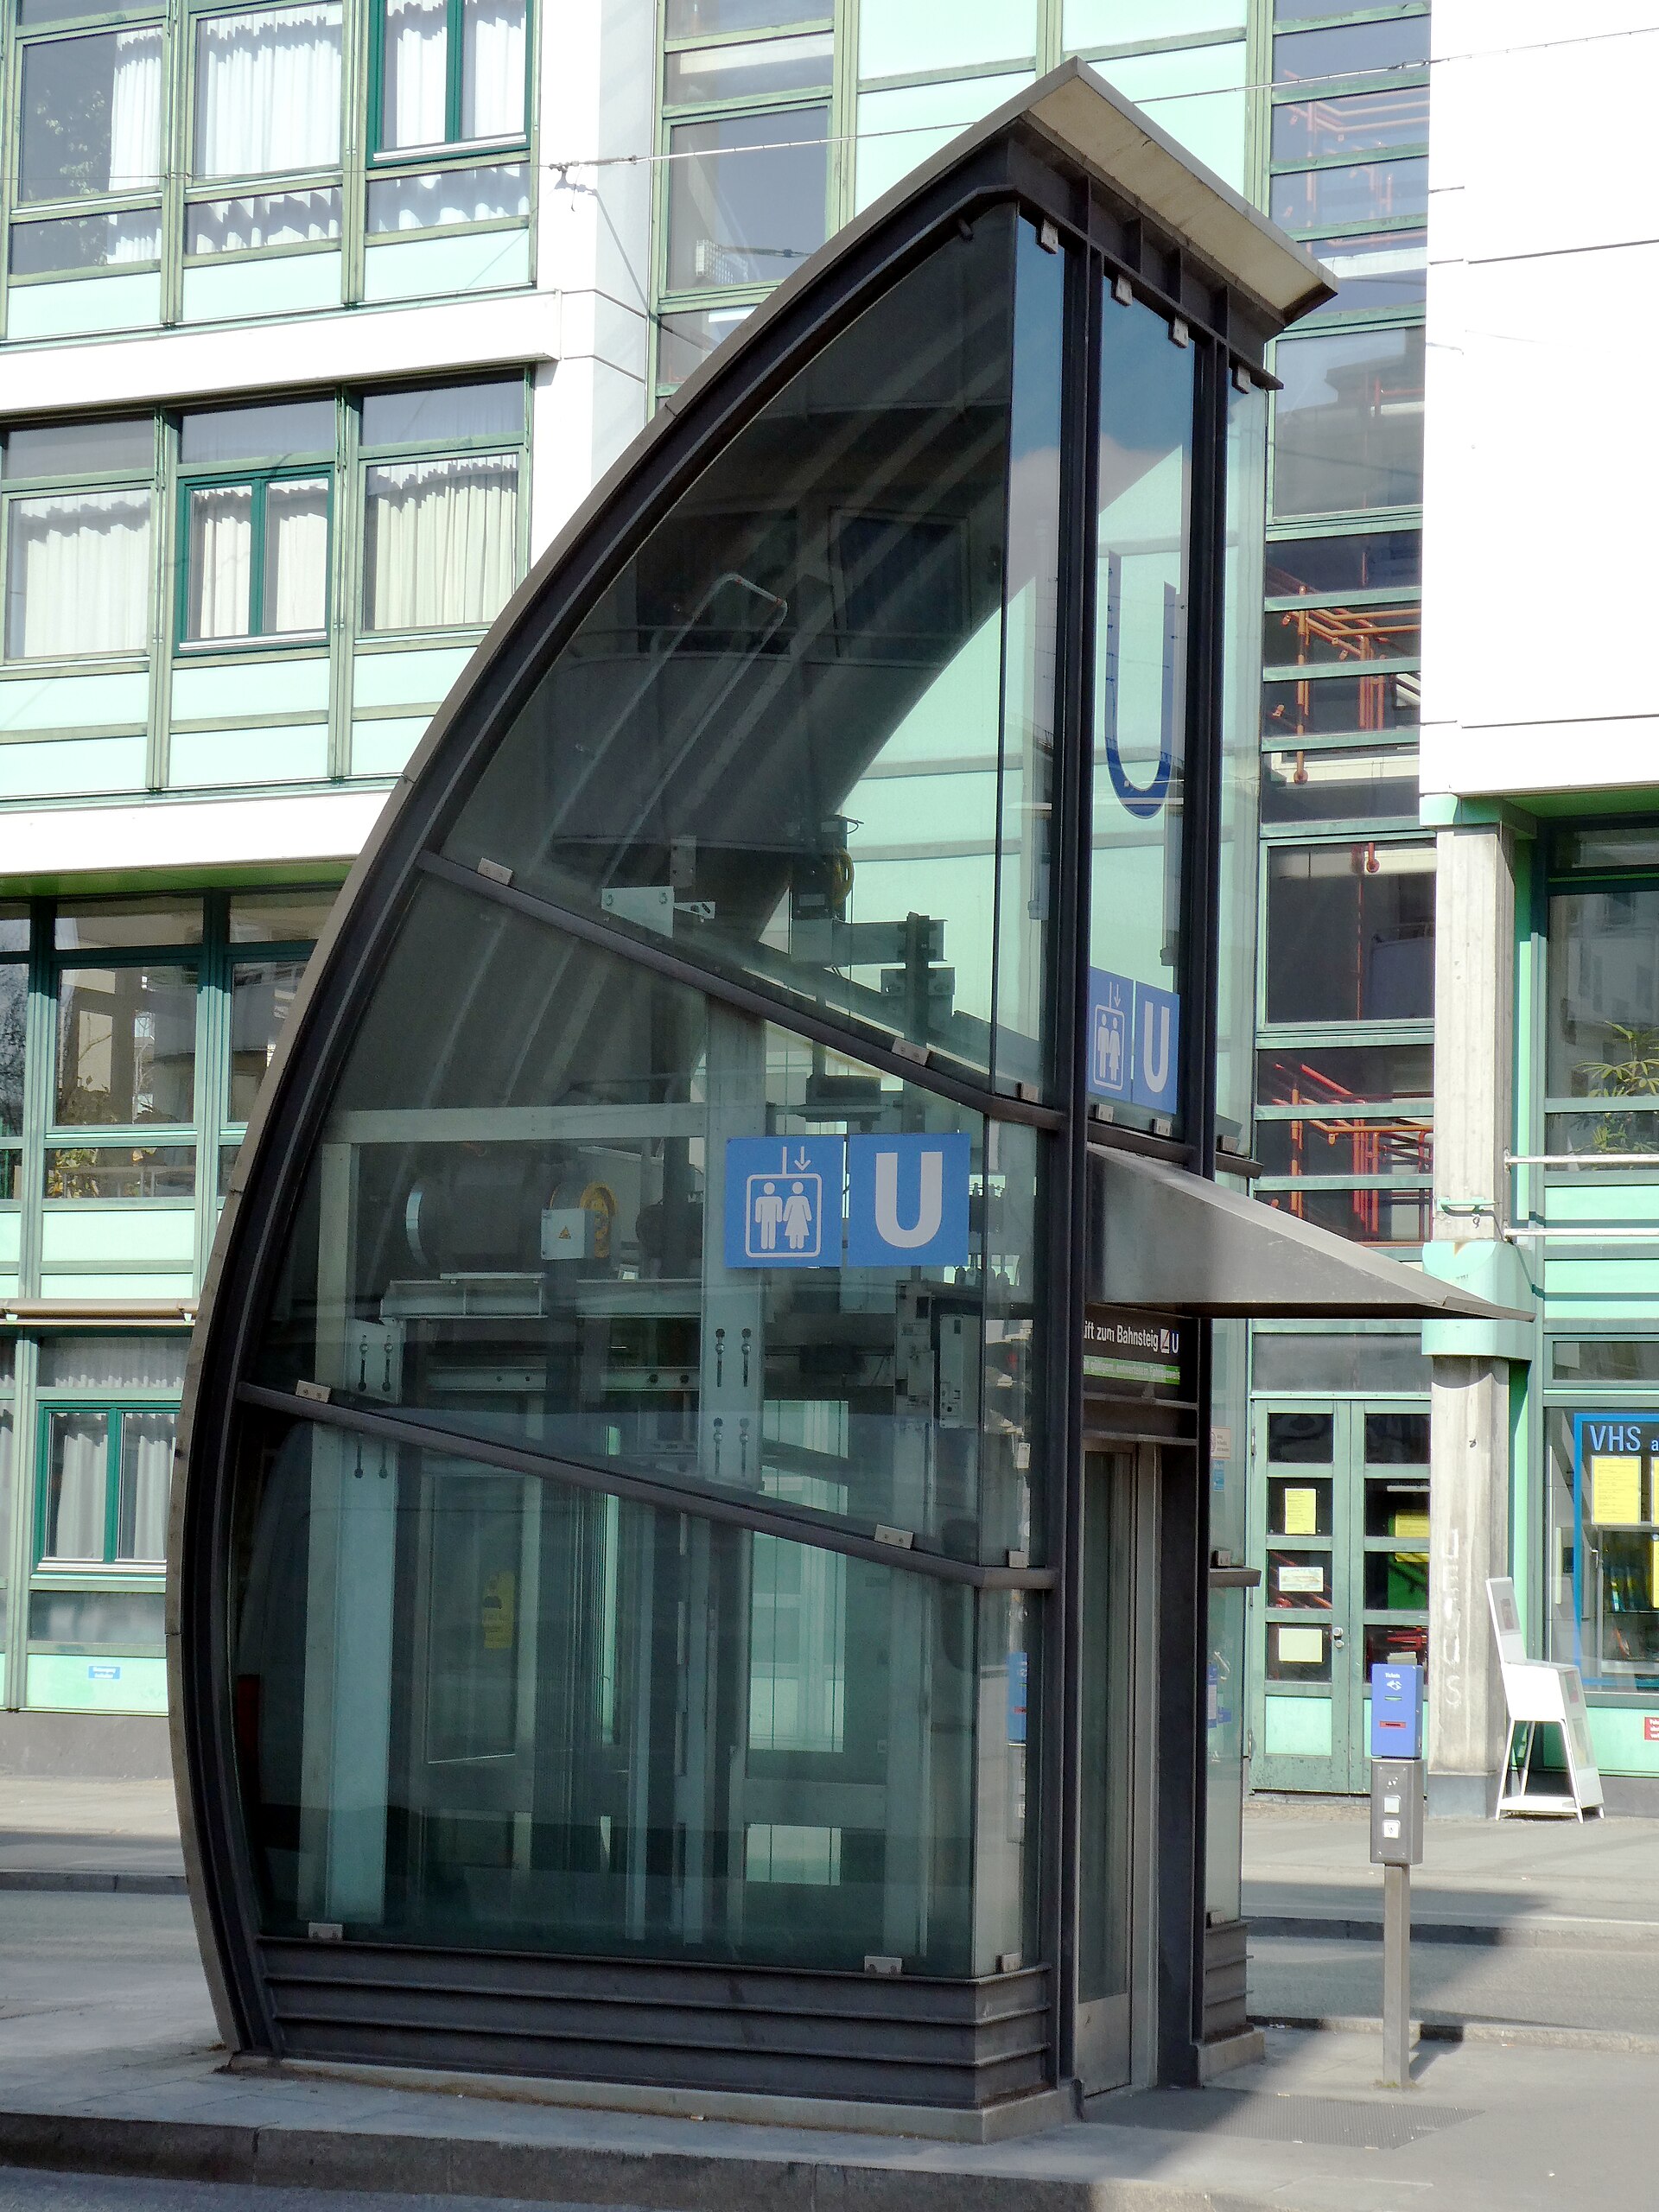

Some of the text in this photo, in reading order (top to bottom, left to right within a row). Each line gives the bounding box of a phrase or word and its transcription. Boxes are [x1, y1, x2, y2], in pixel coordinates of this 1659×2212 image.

[1104, 551, 1176, 819] U
[1145, 1001, 1170, 1092] U
[874, 1152, 944, 1248] U
[1096, 1325, 1115, 1342] zum
[1116, 1325, 1159, 1351] Bahnsteig
[1172, 1333, 1179, 1353] U
[1589, 1425, 1641, 1452] VHS
